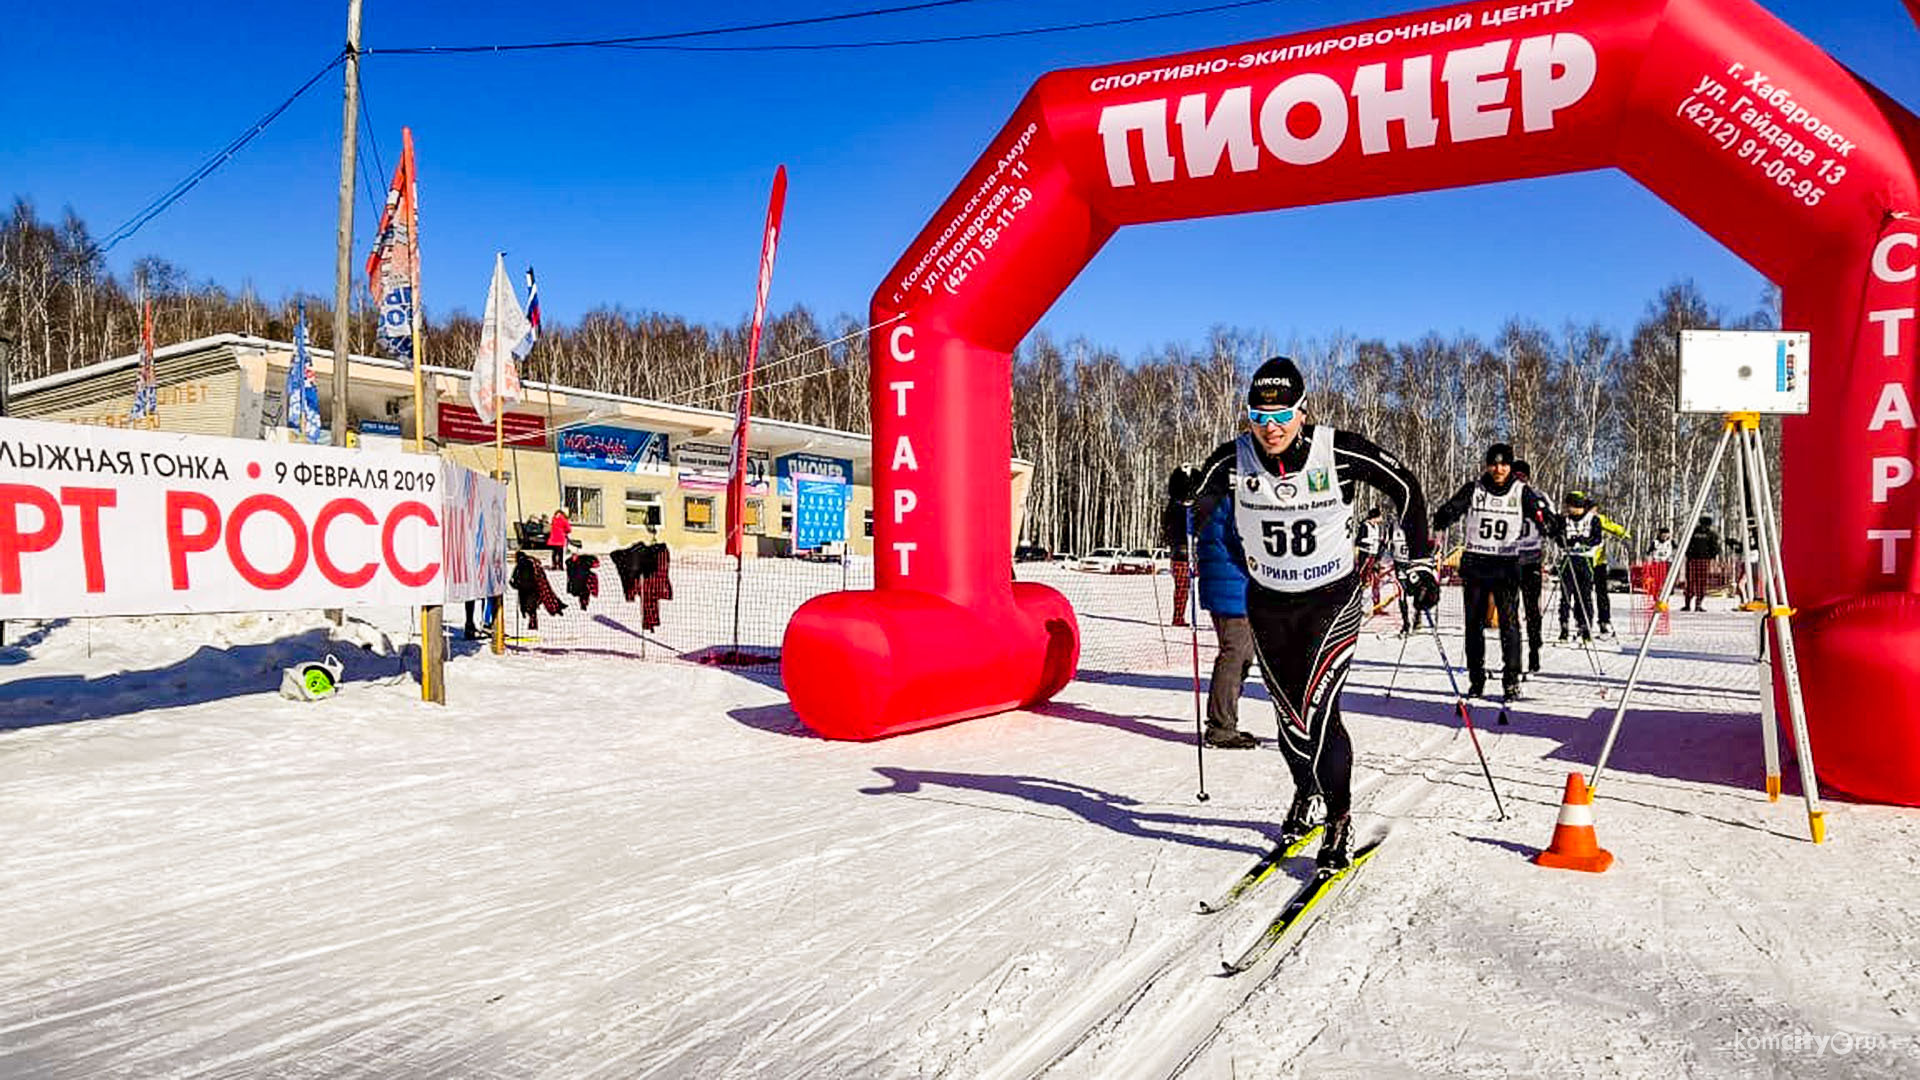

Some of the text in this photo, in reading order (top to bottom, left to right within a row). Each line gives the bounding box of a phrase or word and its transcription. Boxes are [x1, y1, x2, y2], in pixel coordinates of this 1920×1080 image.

[1090, 0, 1574, 92] СПОРТИВНО-ЭКИПИРОВОЧНЫЙ ЦЕНТР
[1098, 32, 1597, 187] ПИОНЕР
[1676, 95, 1826, 206] (4212) 91-06-95
[1693, 75, 1847, 185] ул. Гайдара 13
[1727, 62, 1857, 157] г. Хабаровск
[1012, 160, 1029, 180] 11
[943, 187, 1033, 294] (4217) 59-11-30
[889, 325, 919, 576] СТАРТ
[1867, 232, 1919, 574] СТАРТ
[0, 441, 437, 492] ЛЫЖНАЯ ГОНКА 9 ФЕВРАЛЯ 2019
[1261, 519, 1318, 557] 58
[1480, 518, 1508, 540] 59
